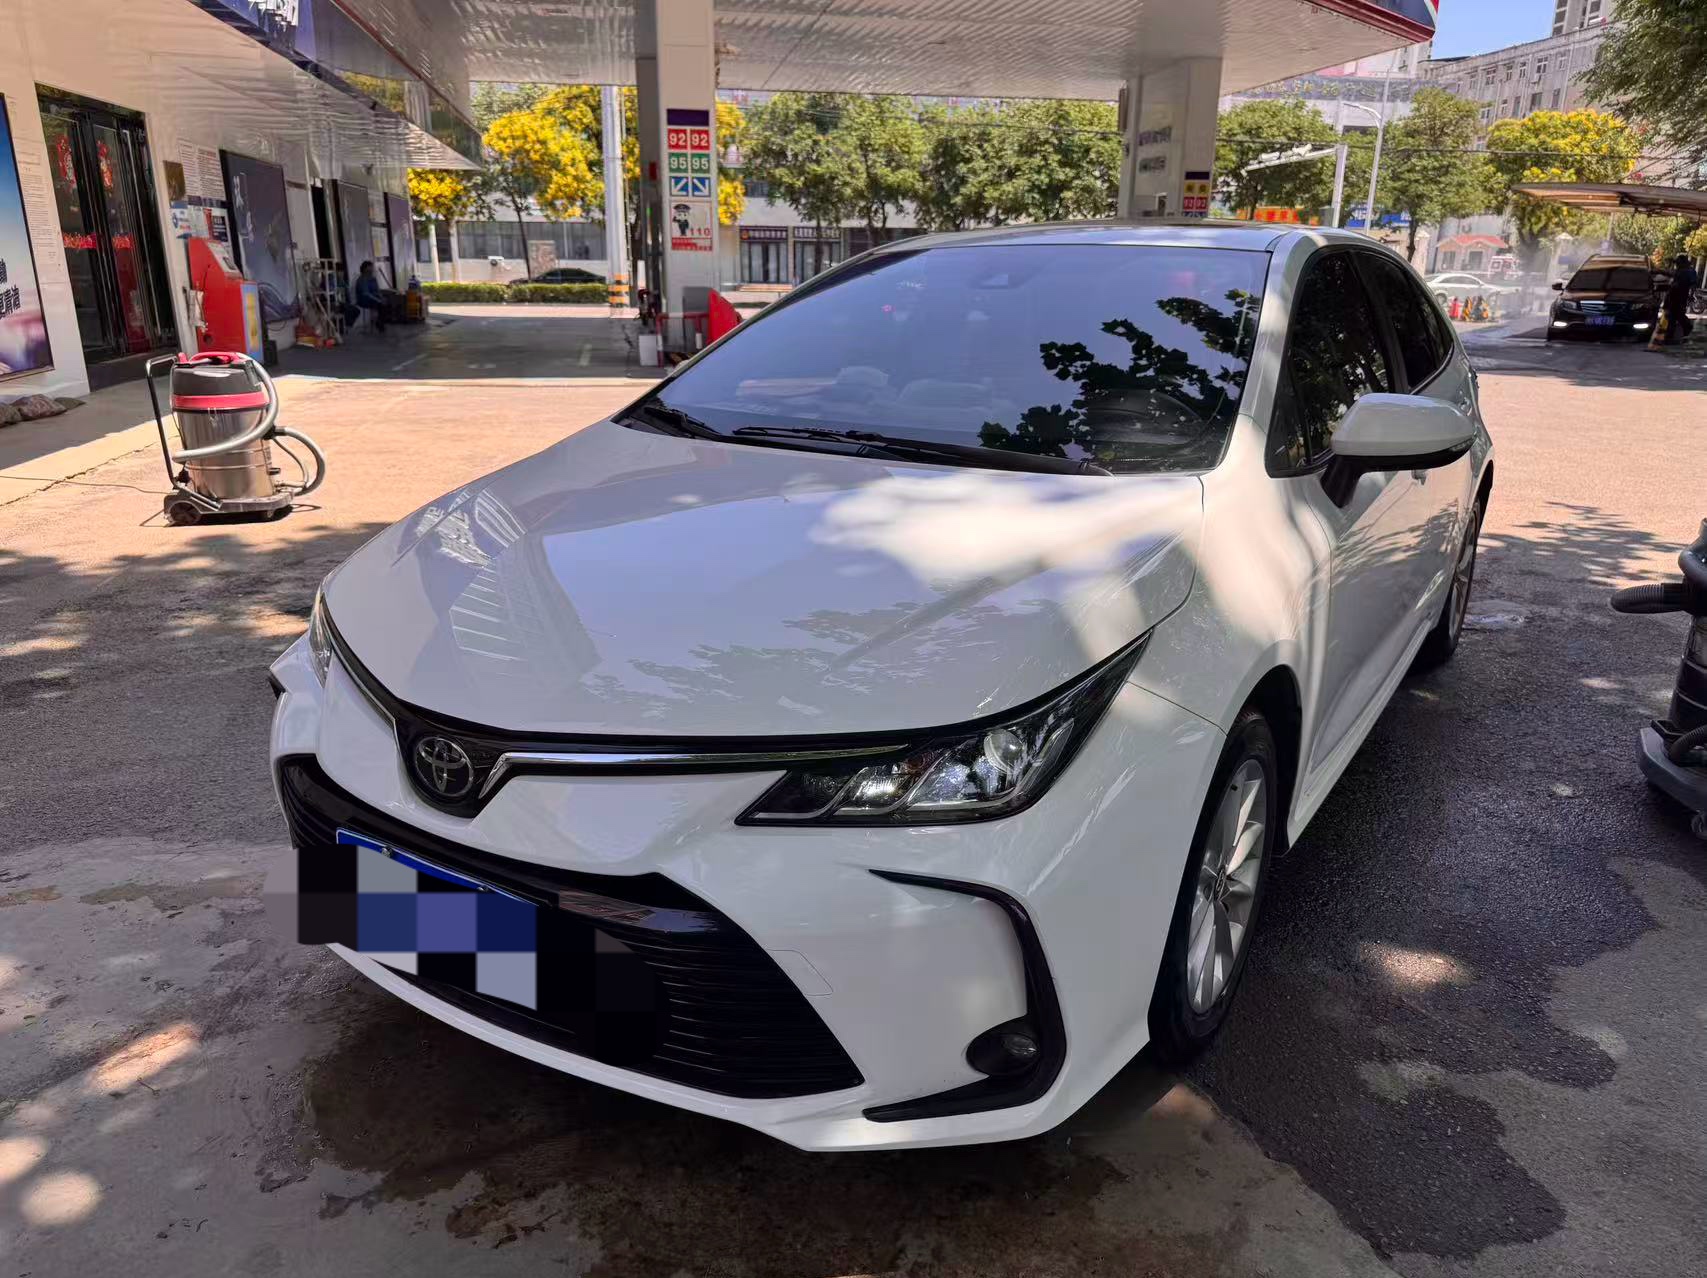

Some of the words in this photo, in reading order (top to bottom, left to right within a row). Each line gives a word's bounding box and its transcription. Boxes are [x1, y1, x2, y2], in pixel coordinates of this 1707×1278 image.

[669, 132, 686, 146] 92
[691, 132, 709, 146] 92
[670, 157, 687, 170] 95
[692, 157, 709, 170] 95
[690, 227, 711, 236] 110
